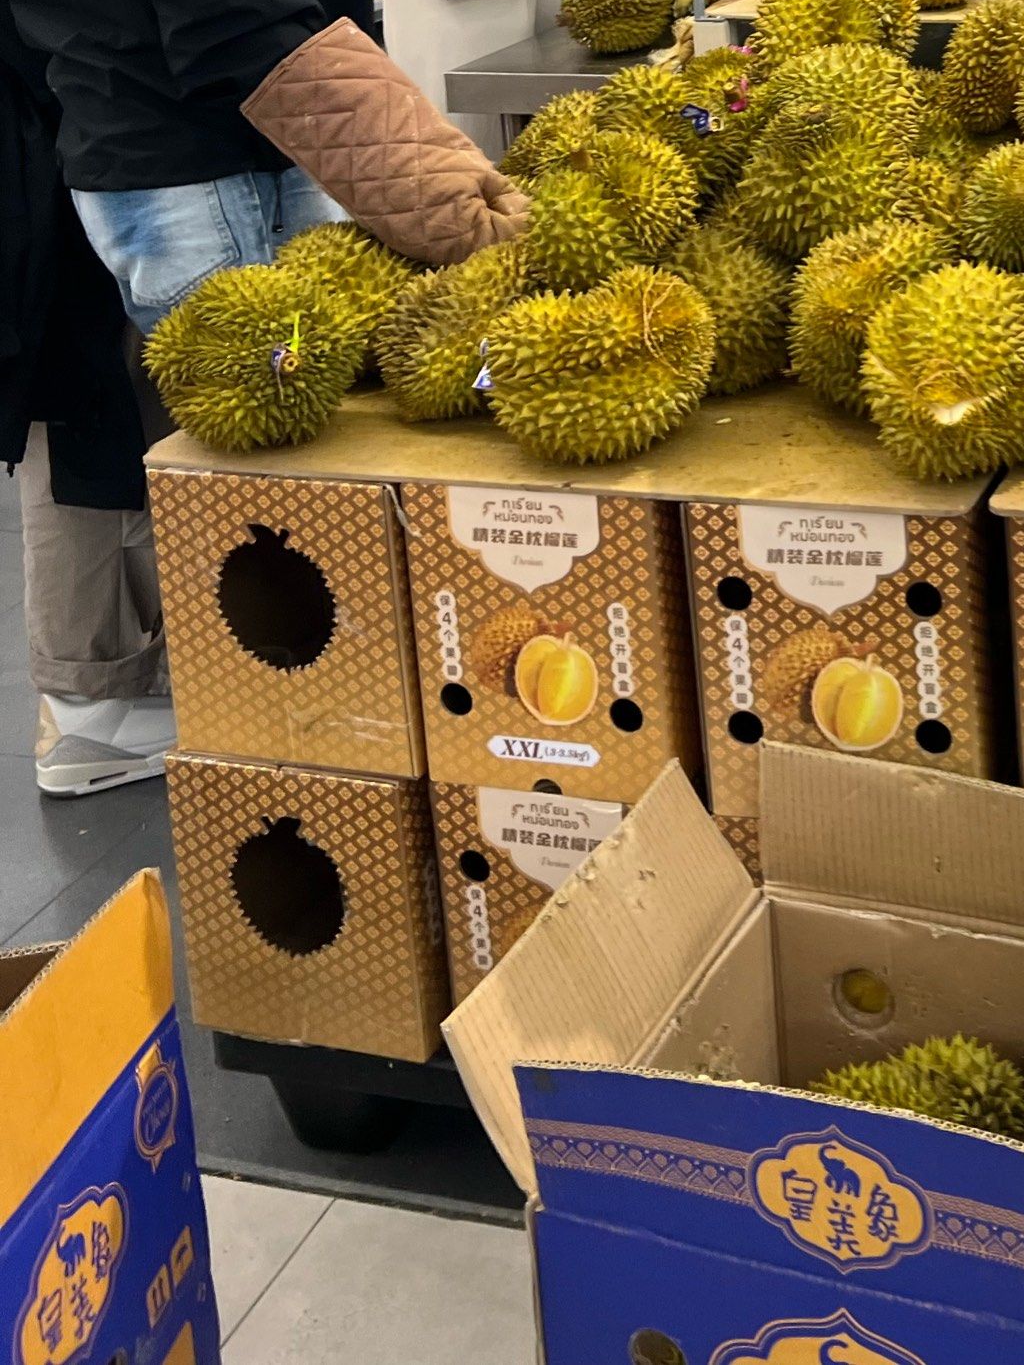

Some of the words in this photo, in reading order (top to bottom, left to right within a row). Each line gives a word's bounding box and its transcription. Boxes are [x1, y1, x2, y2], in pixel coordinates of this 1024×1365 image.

[472, 527, 578, 548] 精装金枕榴莲
[766, 548, 883, 567] 精装金枕榴莲
[501, 739, 543, 760] XXL
